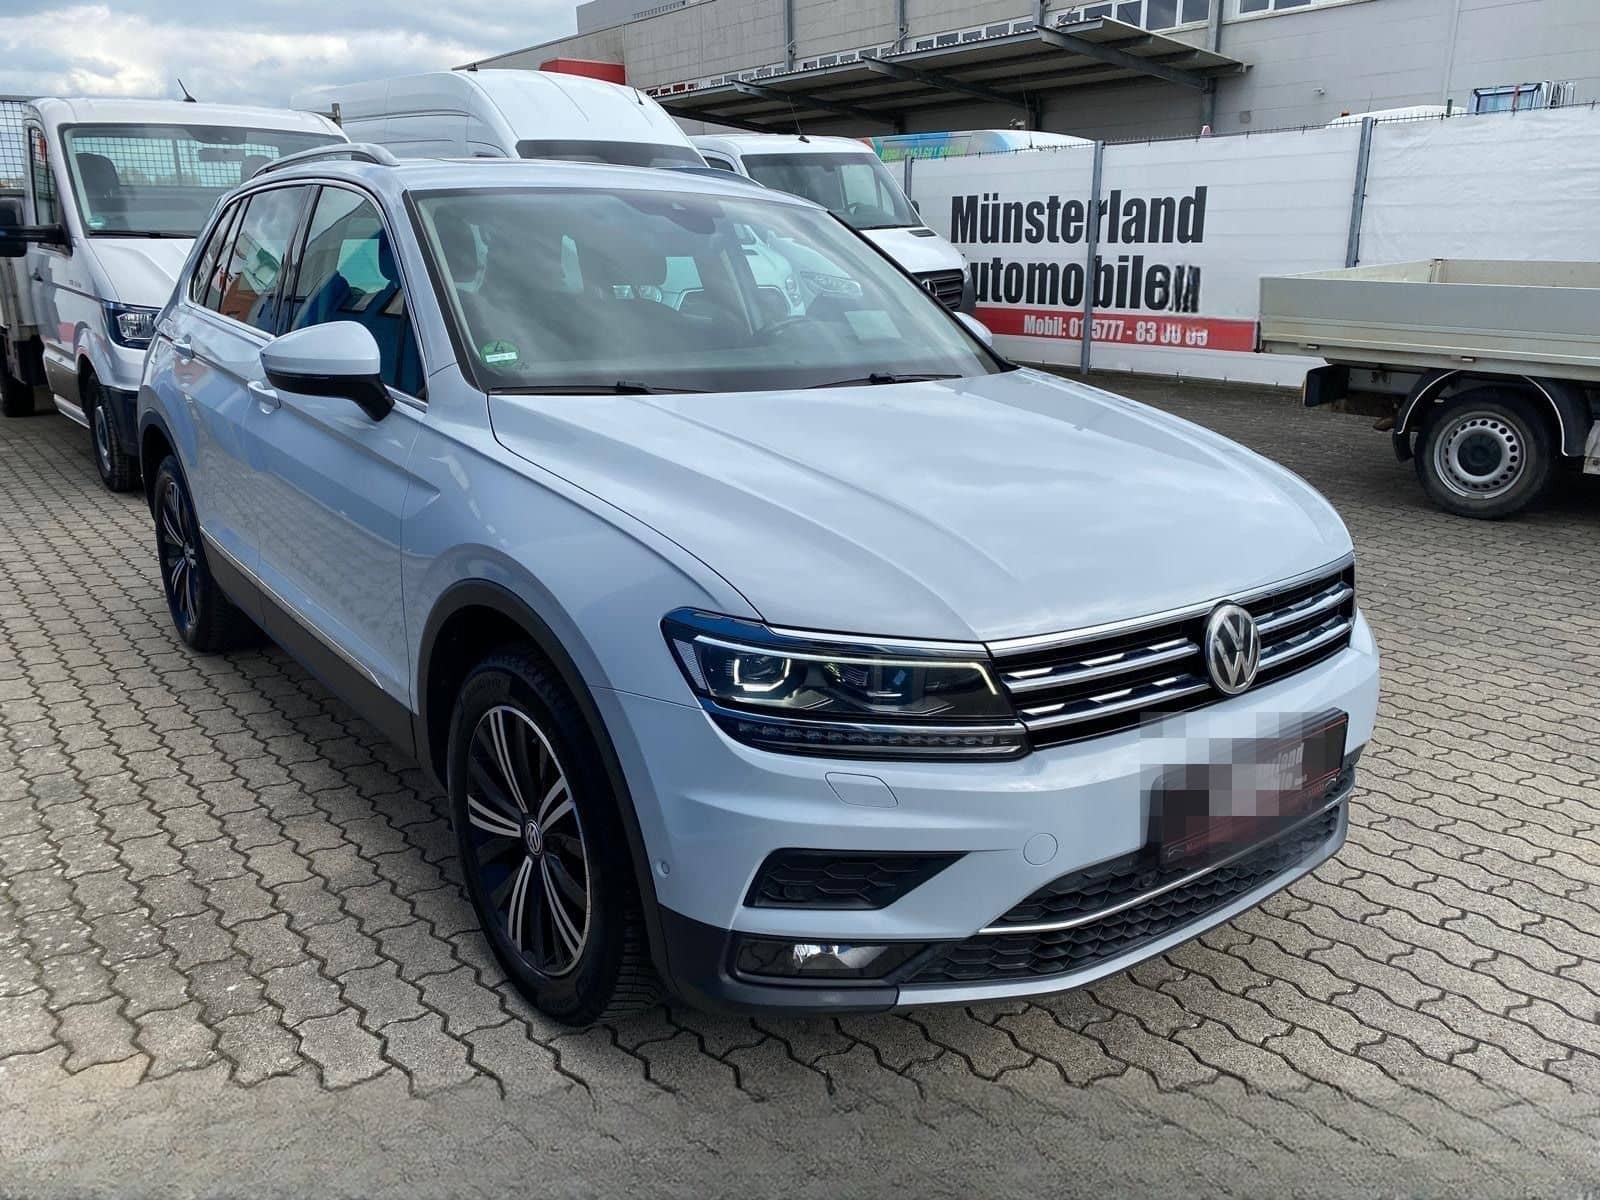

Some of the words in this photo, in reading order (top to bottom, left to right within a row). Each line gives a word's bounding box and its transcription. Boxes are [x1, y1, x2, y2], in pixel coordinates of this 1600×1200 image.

[951, 186, 1208, 244] Münsterland
[969, 255, 1201, 313] utomobilen
[1024, 315, 1066, 337] Mobil:
[1136, 321, 1157, 343] 83
